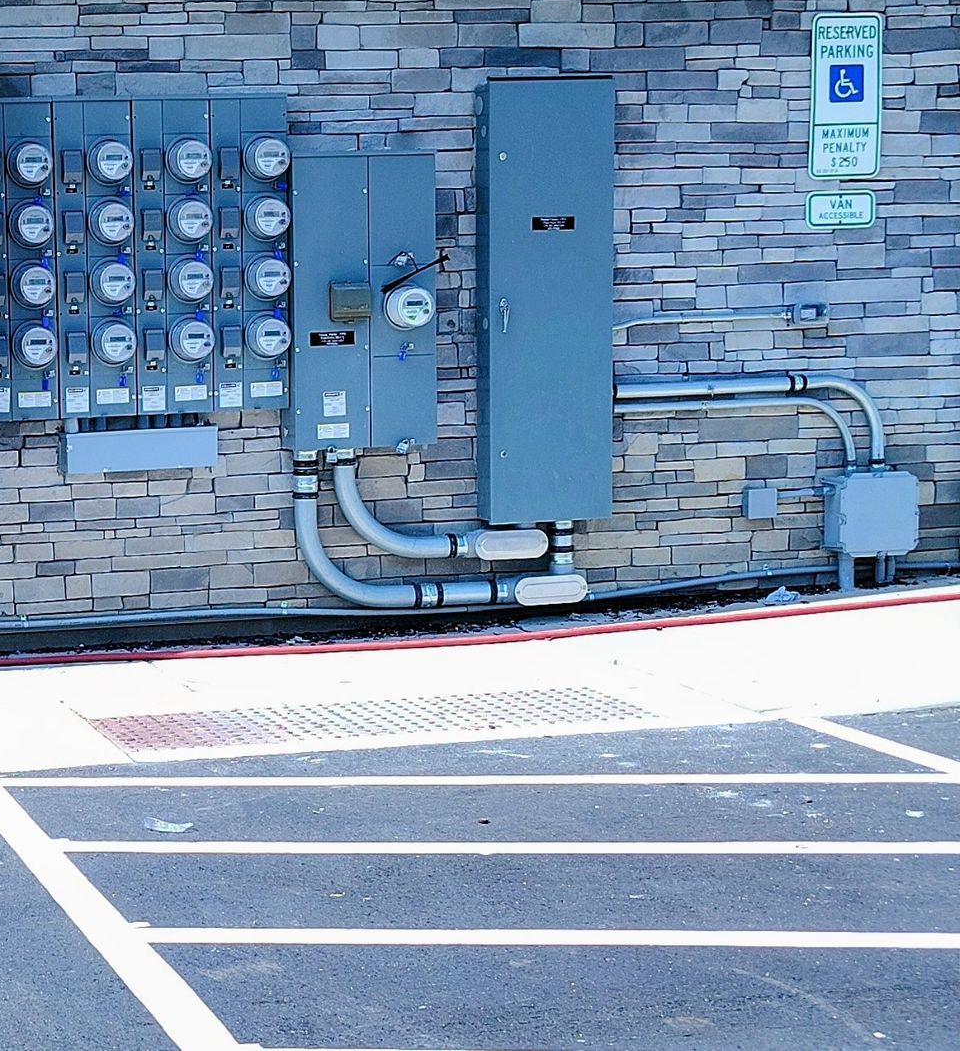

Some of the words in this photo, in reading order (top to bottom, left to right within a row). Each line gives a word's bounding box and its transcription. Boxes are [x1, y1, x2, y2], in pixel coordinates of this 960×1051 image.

[818, 25, 876, 40] RESERVED
[820, 45, 874, 59] PARKING
[821, 127, 870, 139] MAXIMUM
[822, 142, 867, 154] PENALTY
[830, 156, 858, 168] $250
[830, 199, 852, 210] VAN
[818, 211, 864, 220] ACCESSIBLE
